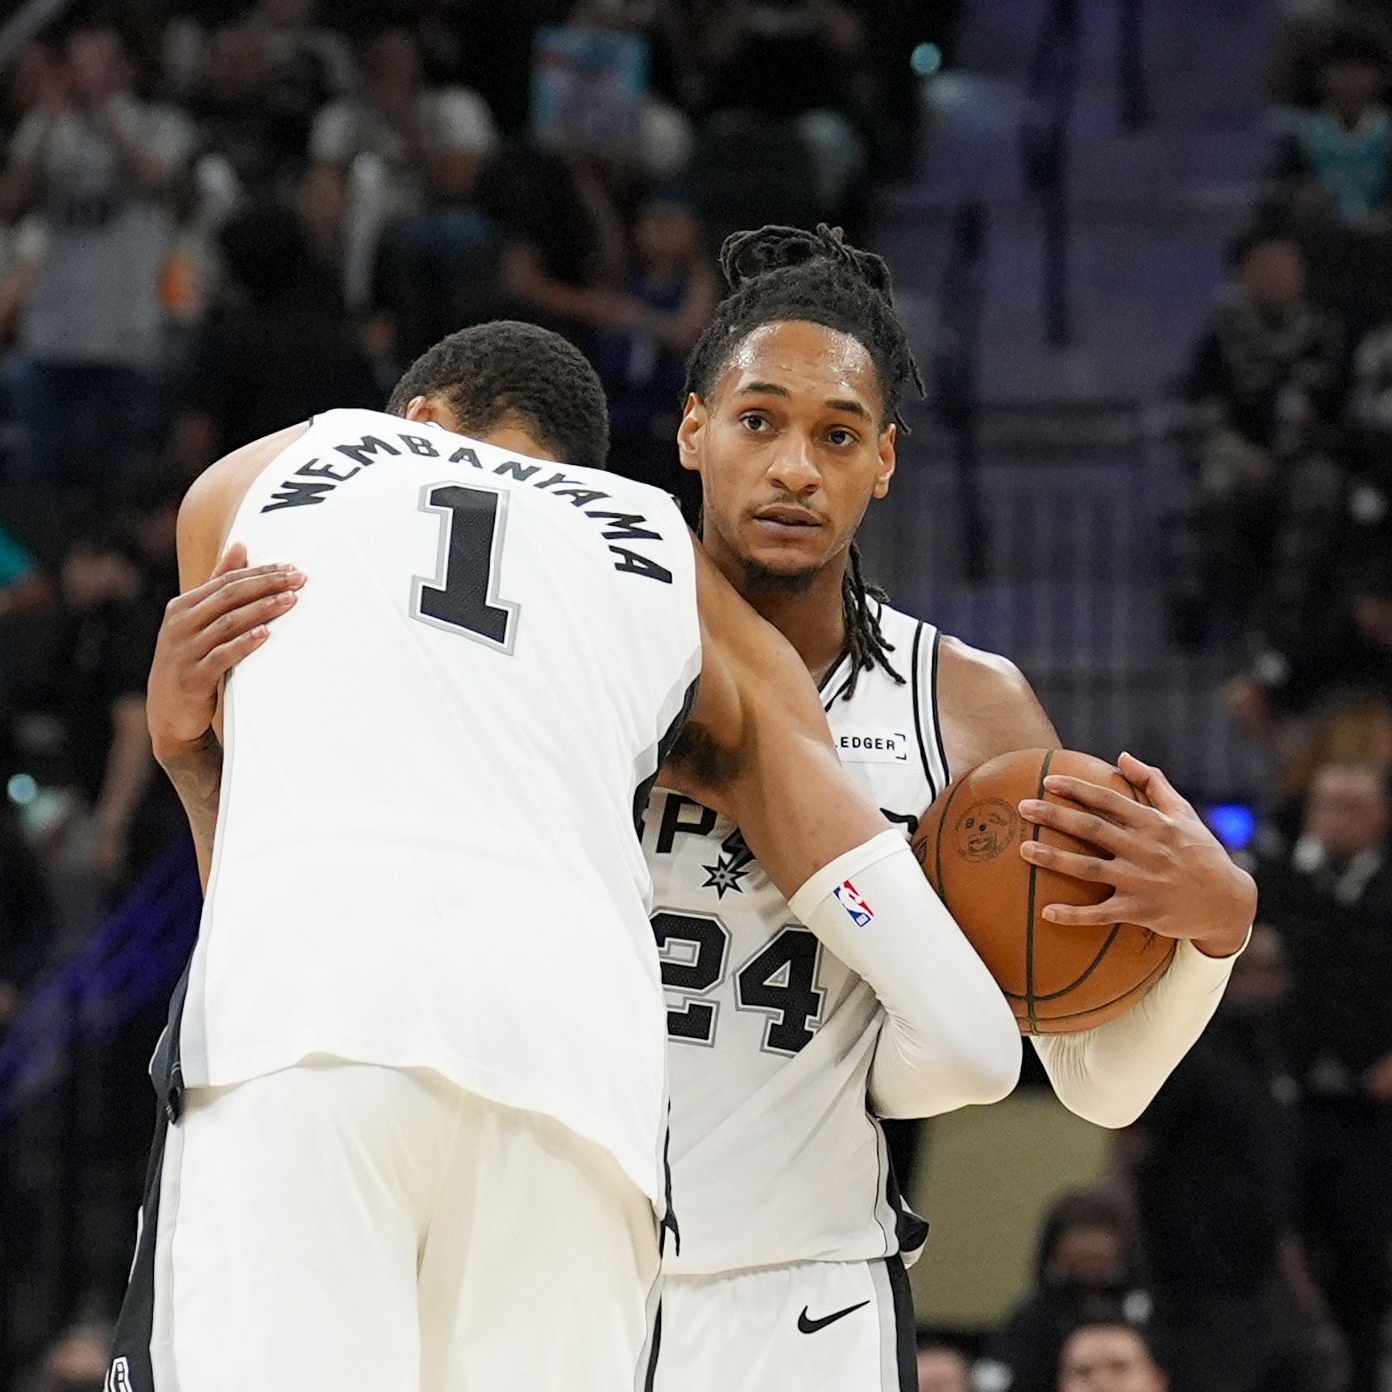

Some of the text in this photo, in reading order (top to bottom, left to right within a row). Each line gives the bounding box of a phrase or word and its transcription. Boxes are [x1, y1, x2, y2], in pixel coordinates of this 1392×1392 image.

[259, 433, 673, 585] WEMBANYAMA
[408, 480, 522, 657] 1
[834, 735, 897, 752] EDGER
[650, 905, 828, 1059] 24
